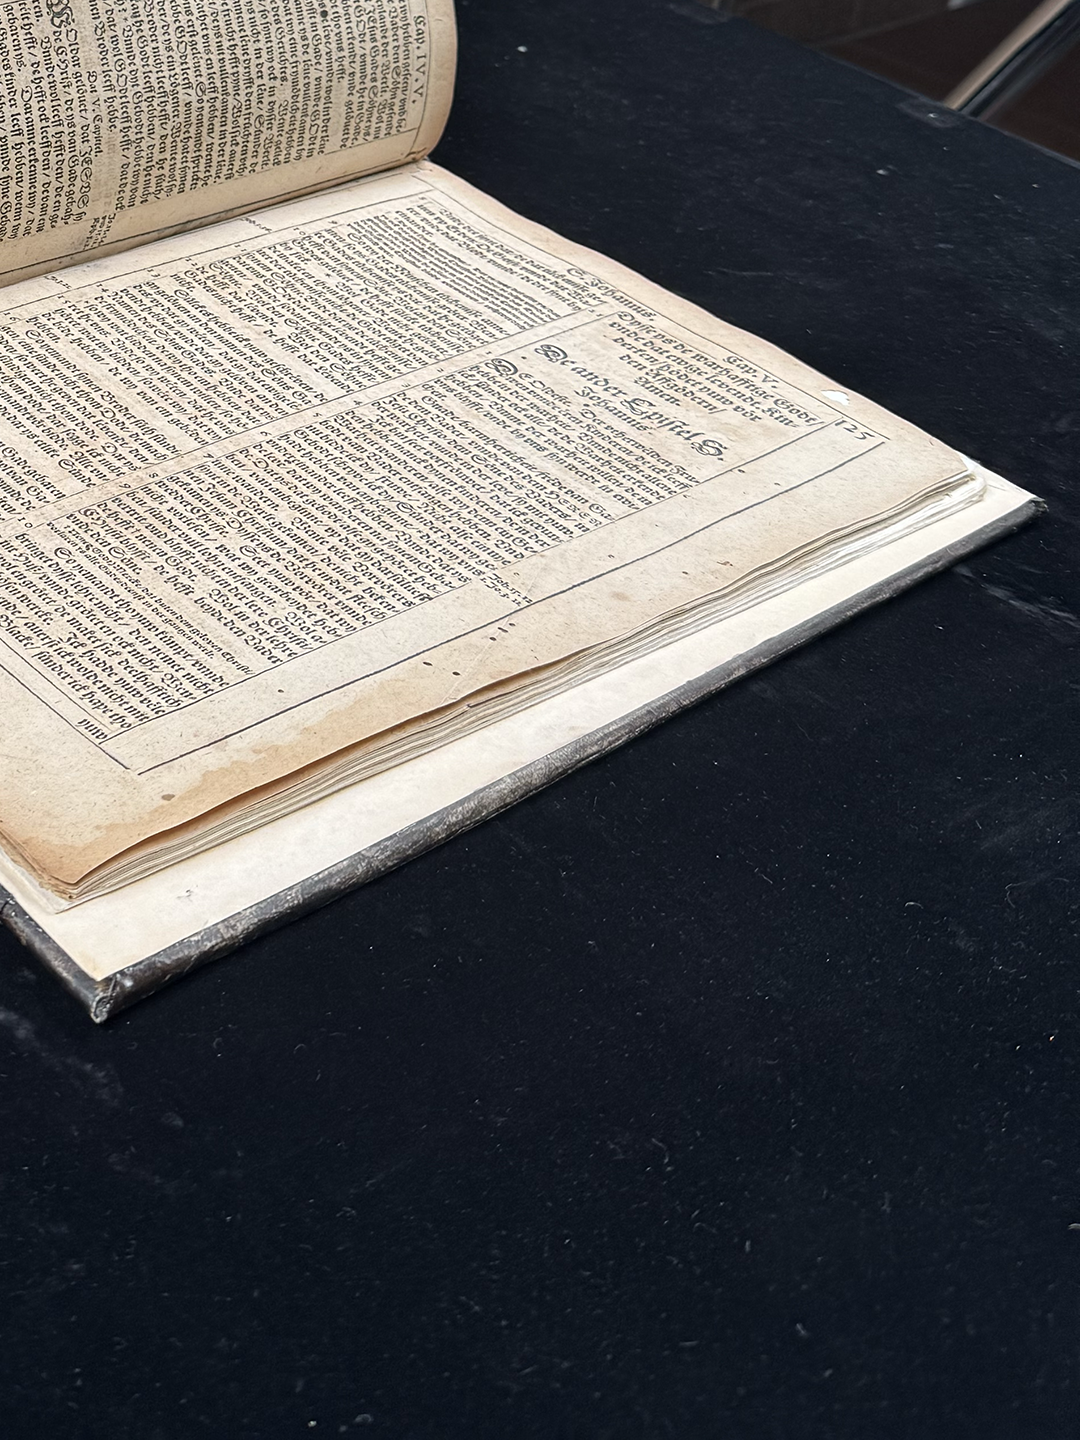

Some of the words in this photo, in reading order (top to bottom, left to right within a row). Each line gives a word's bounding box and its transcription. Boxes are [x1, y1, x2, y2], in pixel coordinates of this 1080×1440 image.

[641, 339, 670, 355] dat
[672, 342, 693, 354] de
[618, 353, 647, 371] den
[128, 627, 152, 646] den
